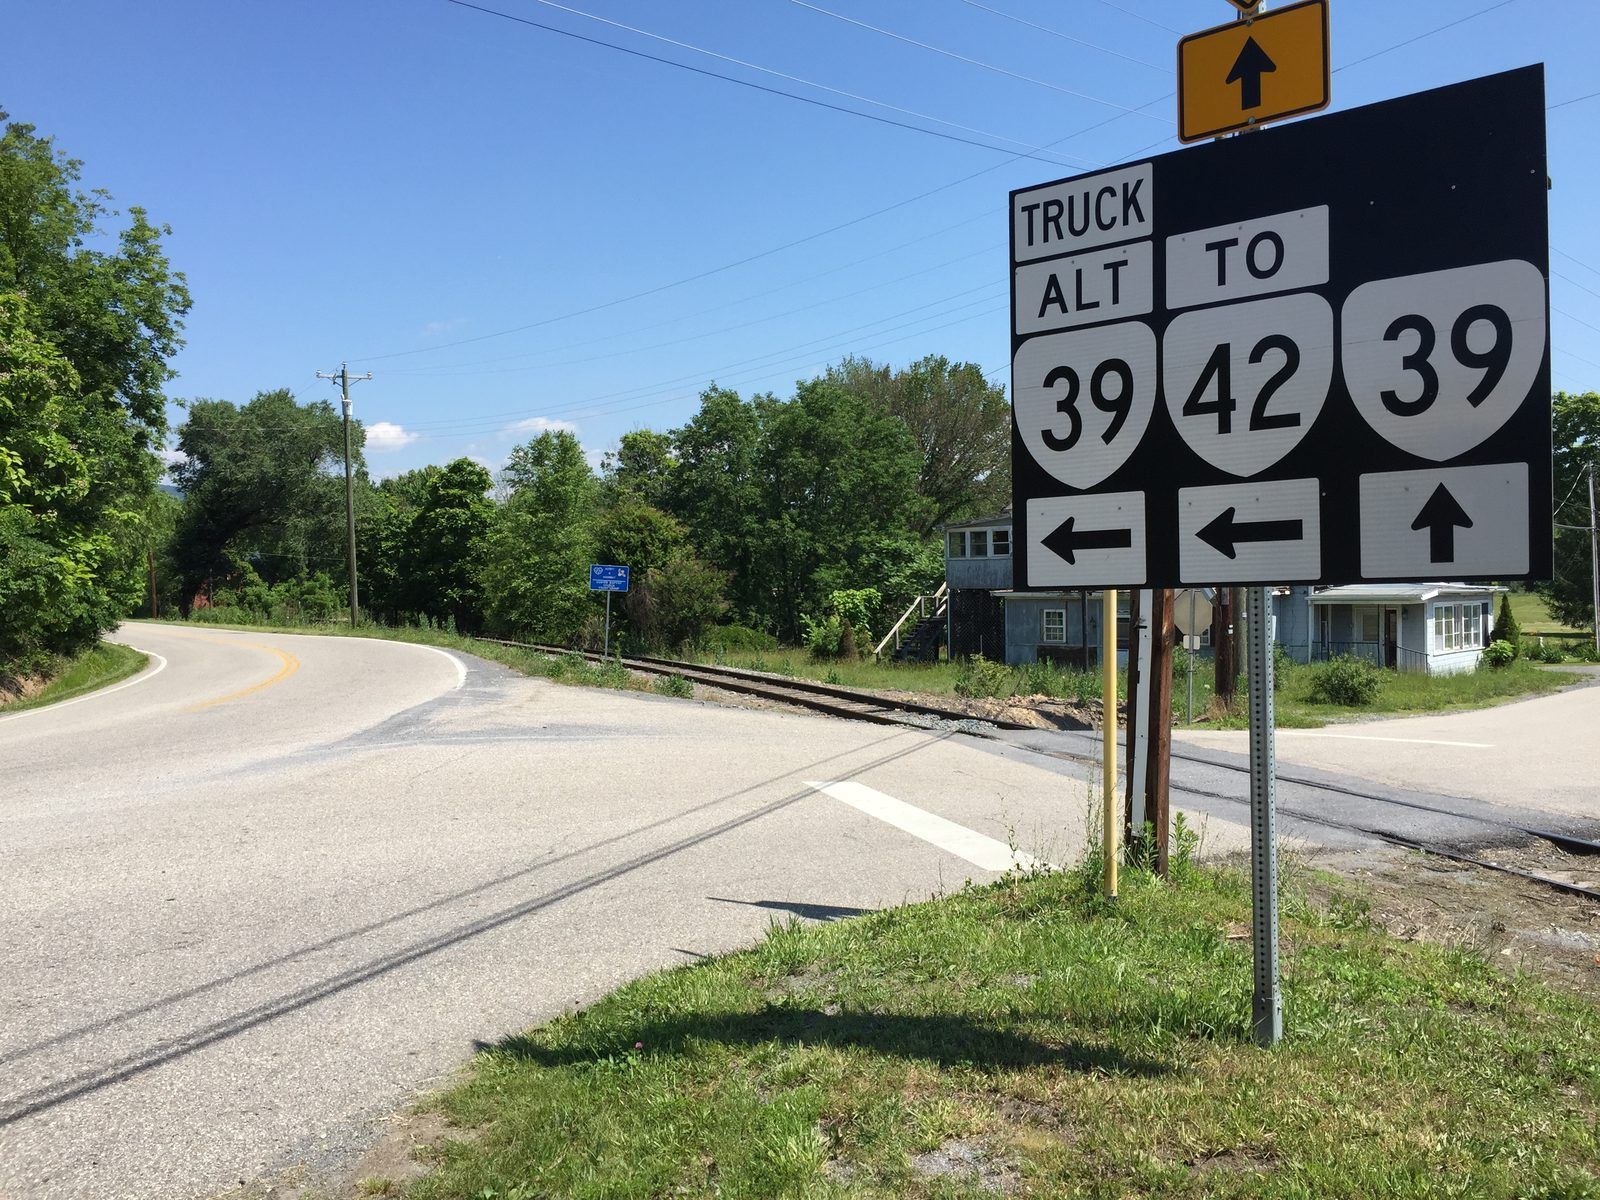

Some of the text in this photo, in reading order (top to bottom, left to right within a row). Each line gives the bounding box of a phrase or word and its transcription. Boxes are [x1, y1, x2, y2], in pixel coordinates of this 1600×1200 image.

[1021, 178, 1145, 246] TRUCK
[1038, 259, 1128, 318] ALT
[1205, 230, 1285, 287] TO
[1182, 334, 1301, 435] 42
[1380, 303, 1513, 417] 39
[1040, 358, 1134, 452] 39
